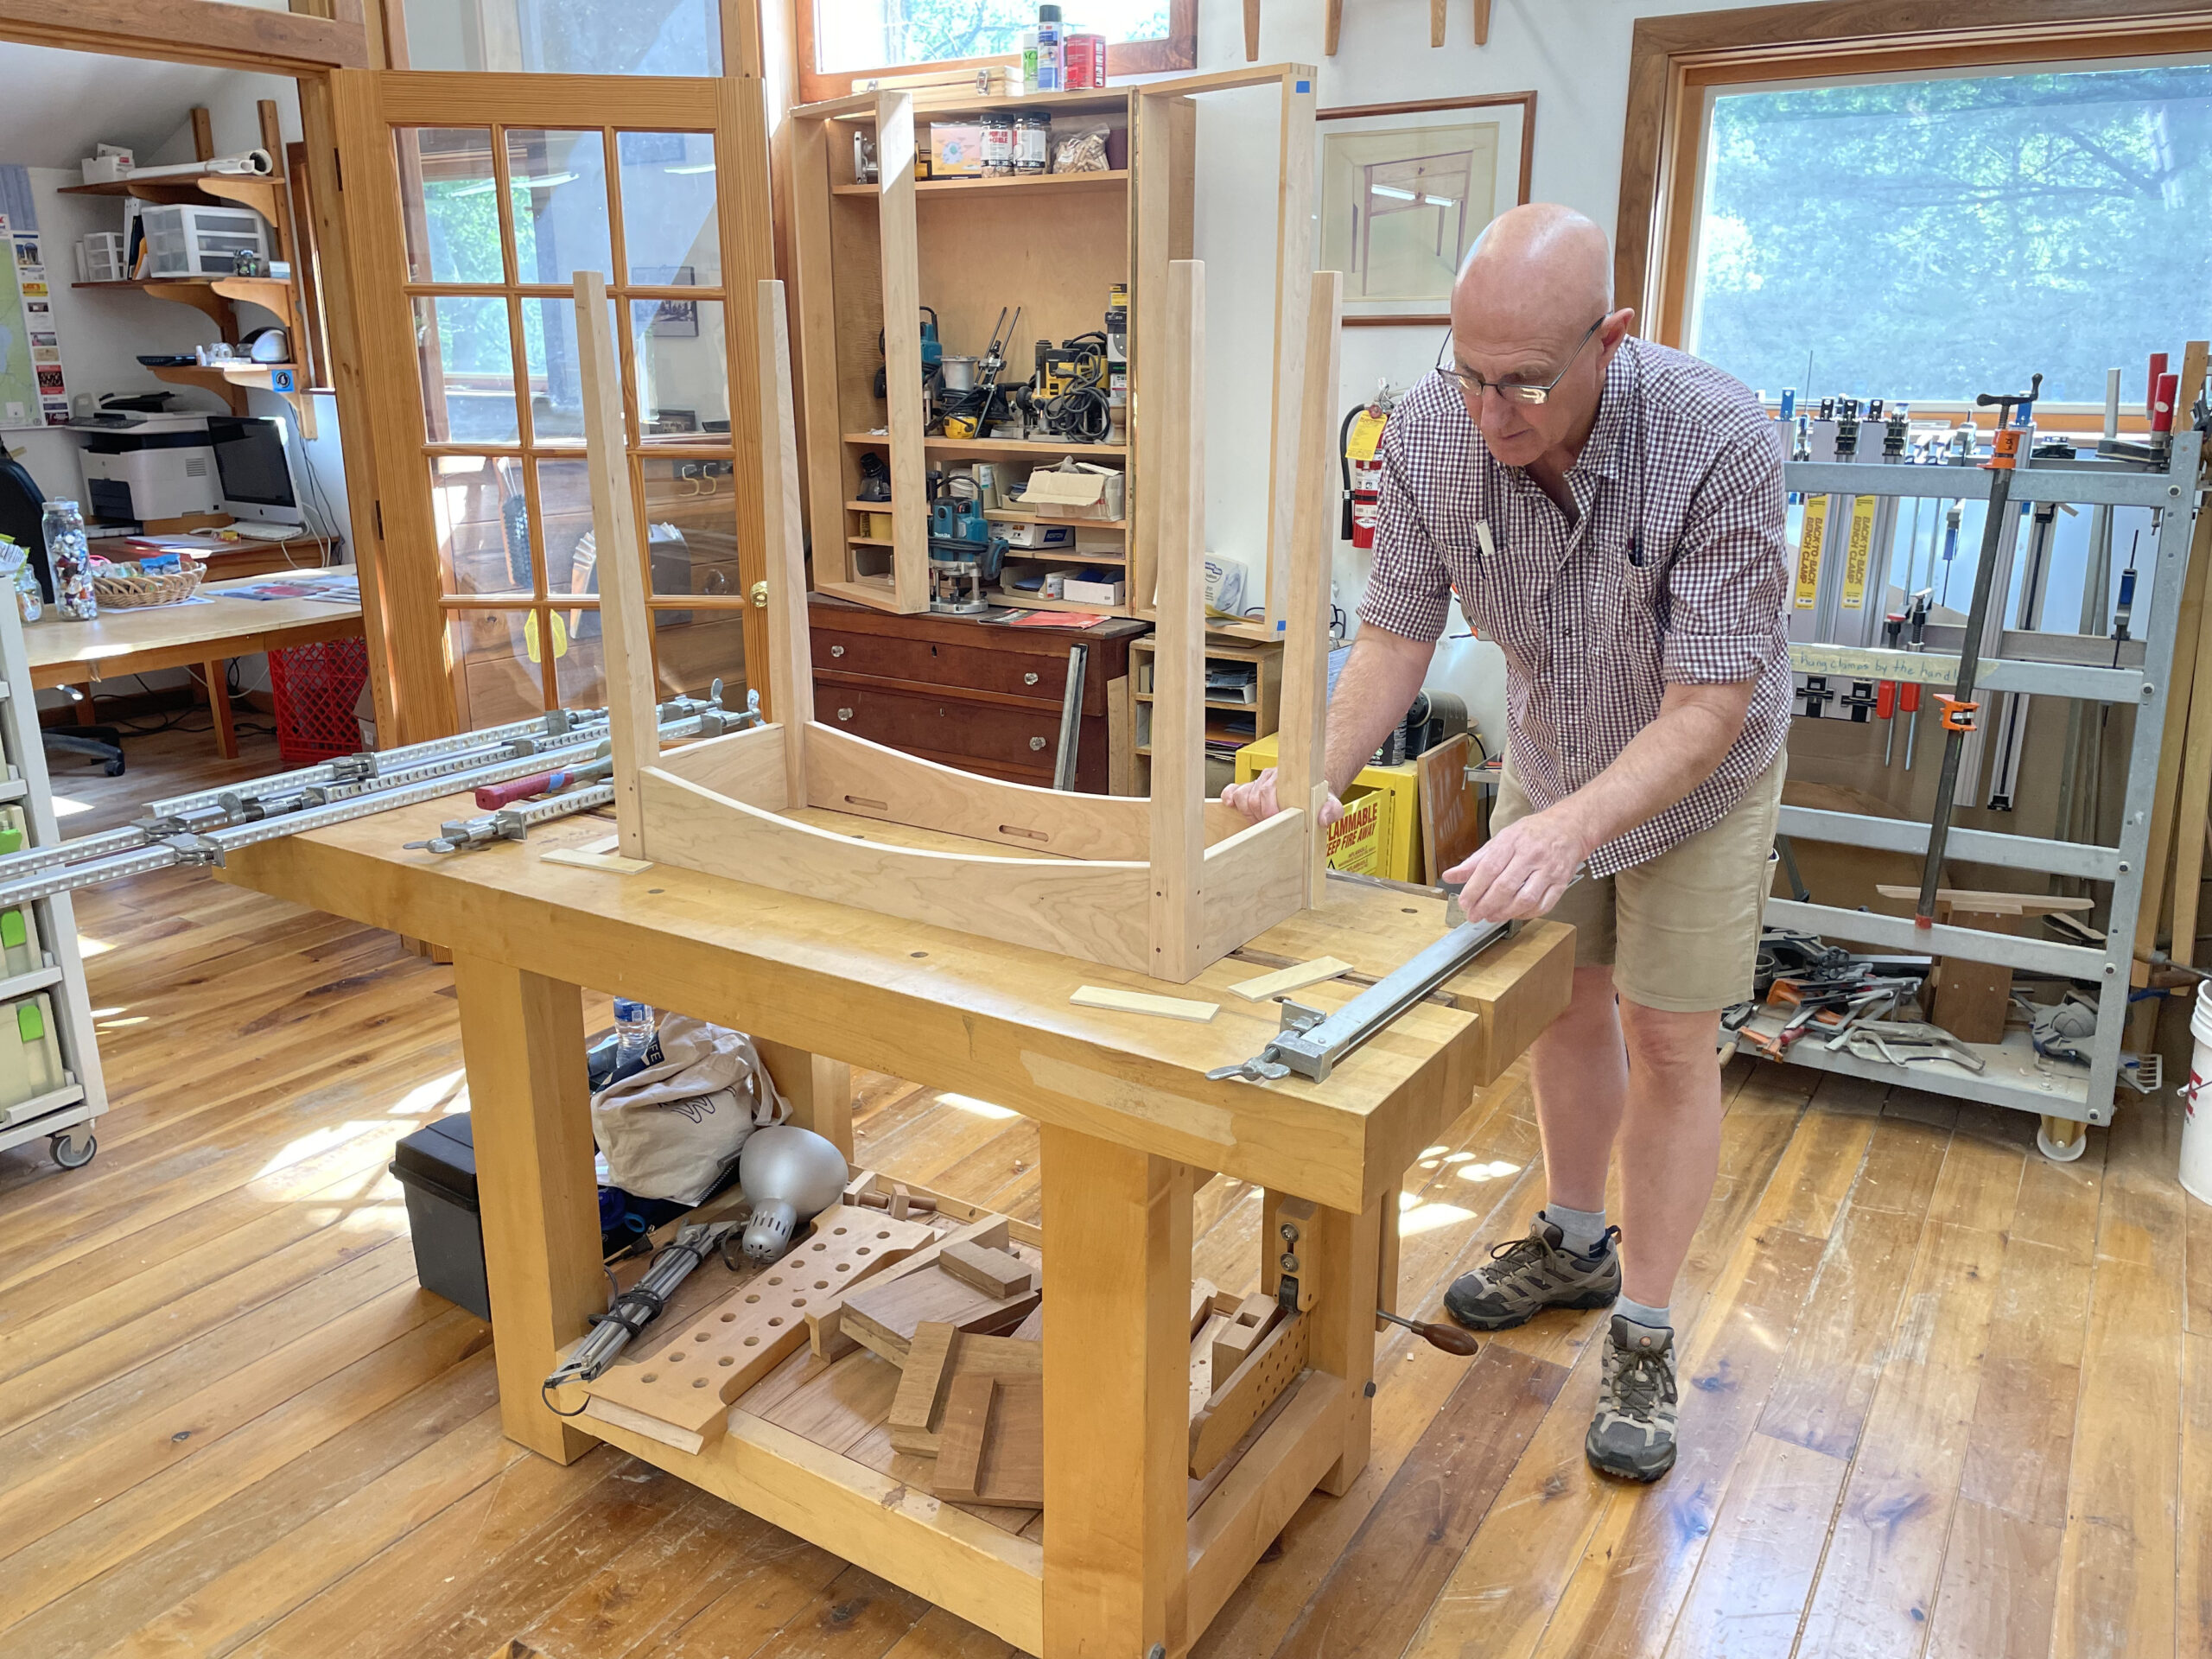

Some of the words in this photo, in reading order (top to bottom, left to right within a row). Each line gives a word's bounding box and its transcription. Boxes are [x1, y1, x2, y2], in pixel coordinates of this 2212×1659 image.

[1803, 517, 1815, 550] BENCH
[1851, 515, 1862, 549] BENCH
[1800, 550, 1810, 584] CLAMP
[1847, 550, 1858, 584] CLAMP
[1830, 657, 1870, 671] clamps
[1875, 659, 1888, 677] by
[1893, 658, 1916, 676] the
[1920, 661, 1958, 682] handl
[1327, 803, 1377, 841] LAMMABLE
[1327, 837, 1341, 857] EEP
[1341, 830, 1357, 850] FIRE
[1357, 822, 1376, 842] AWAY
